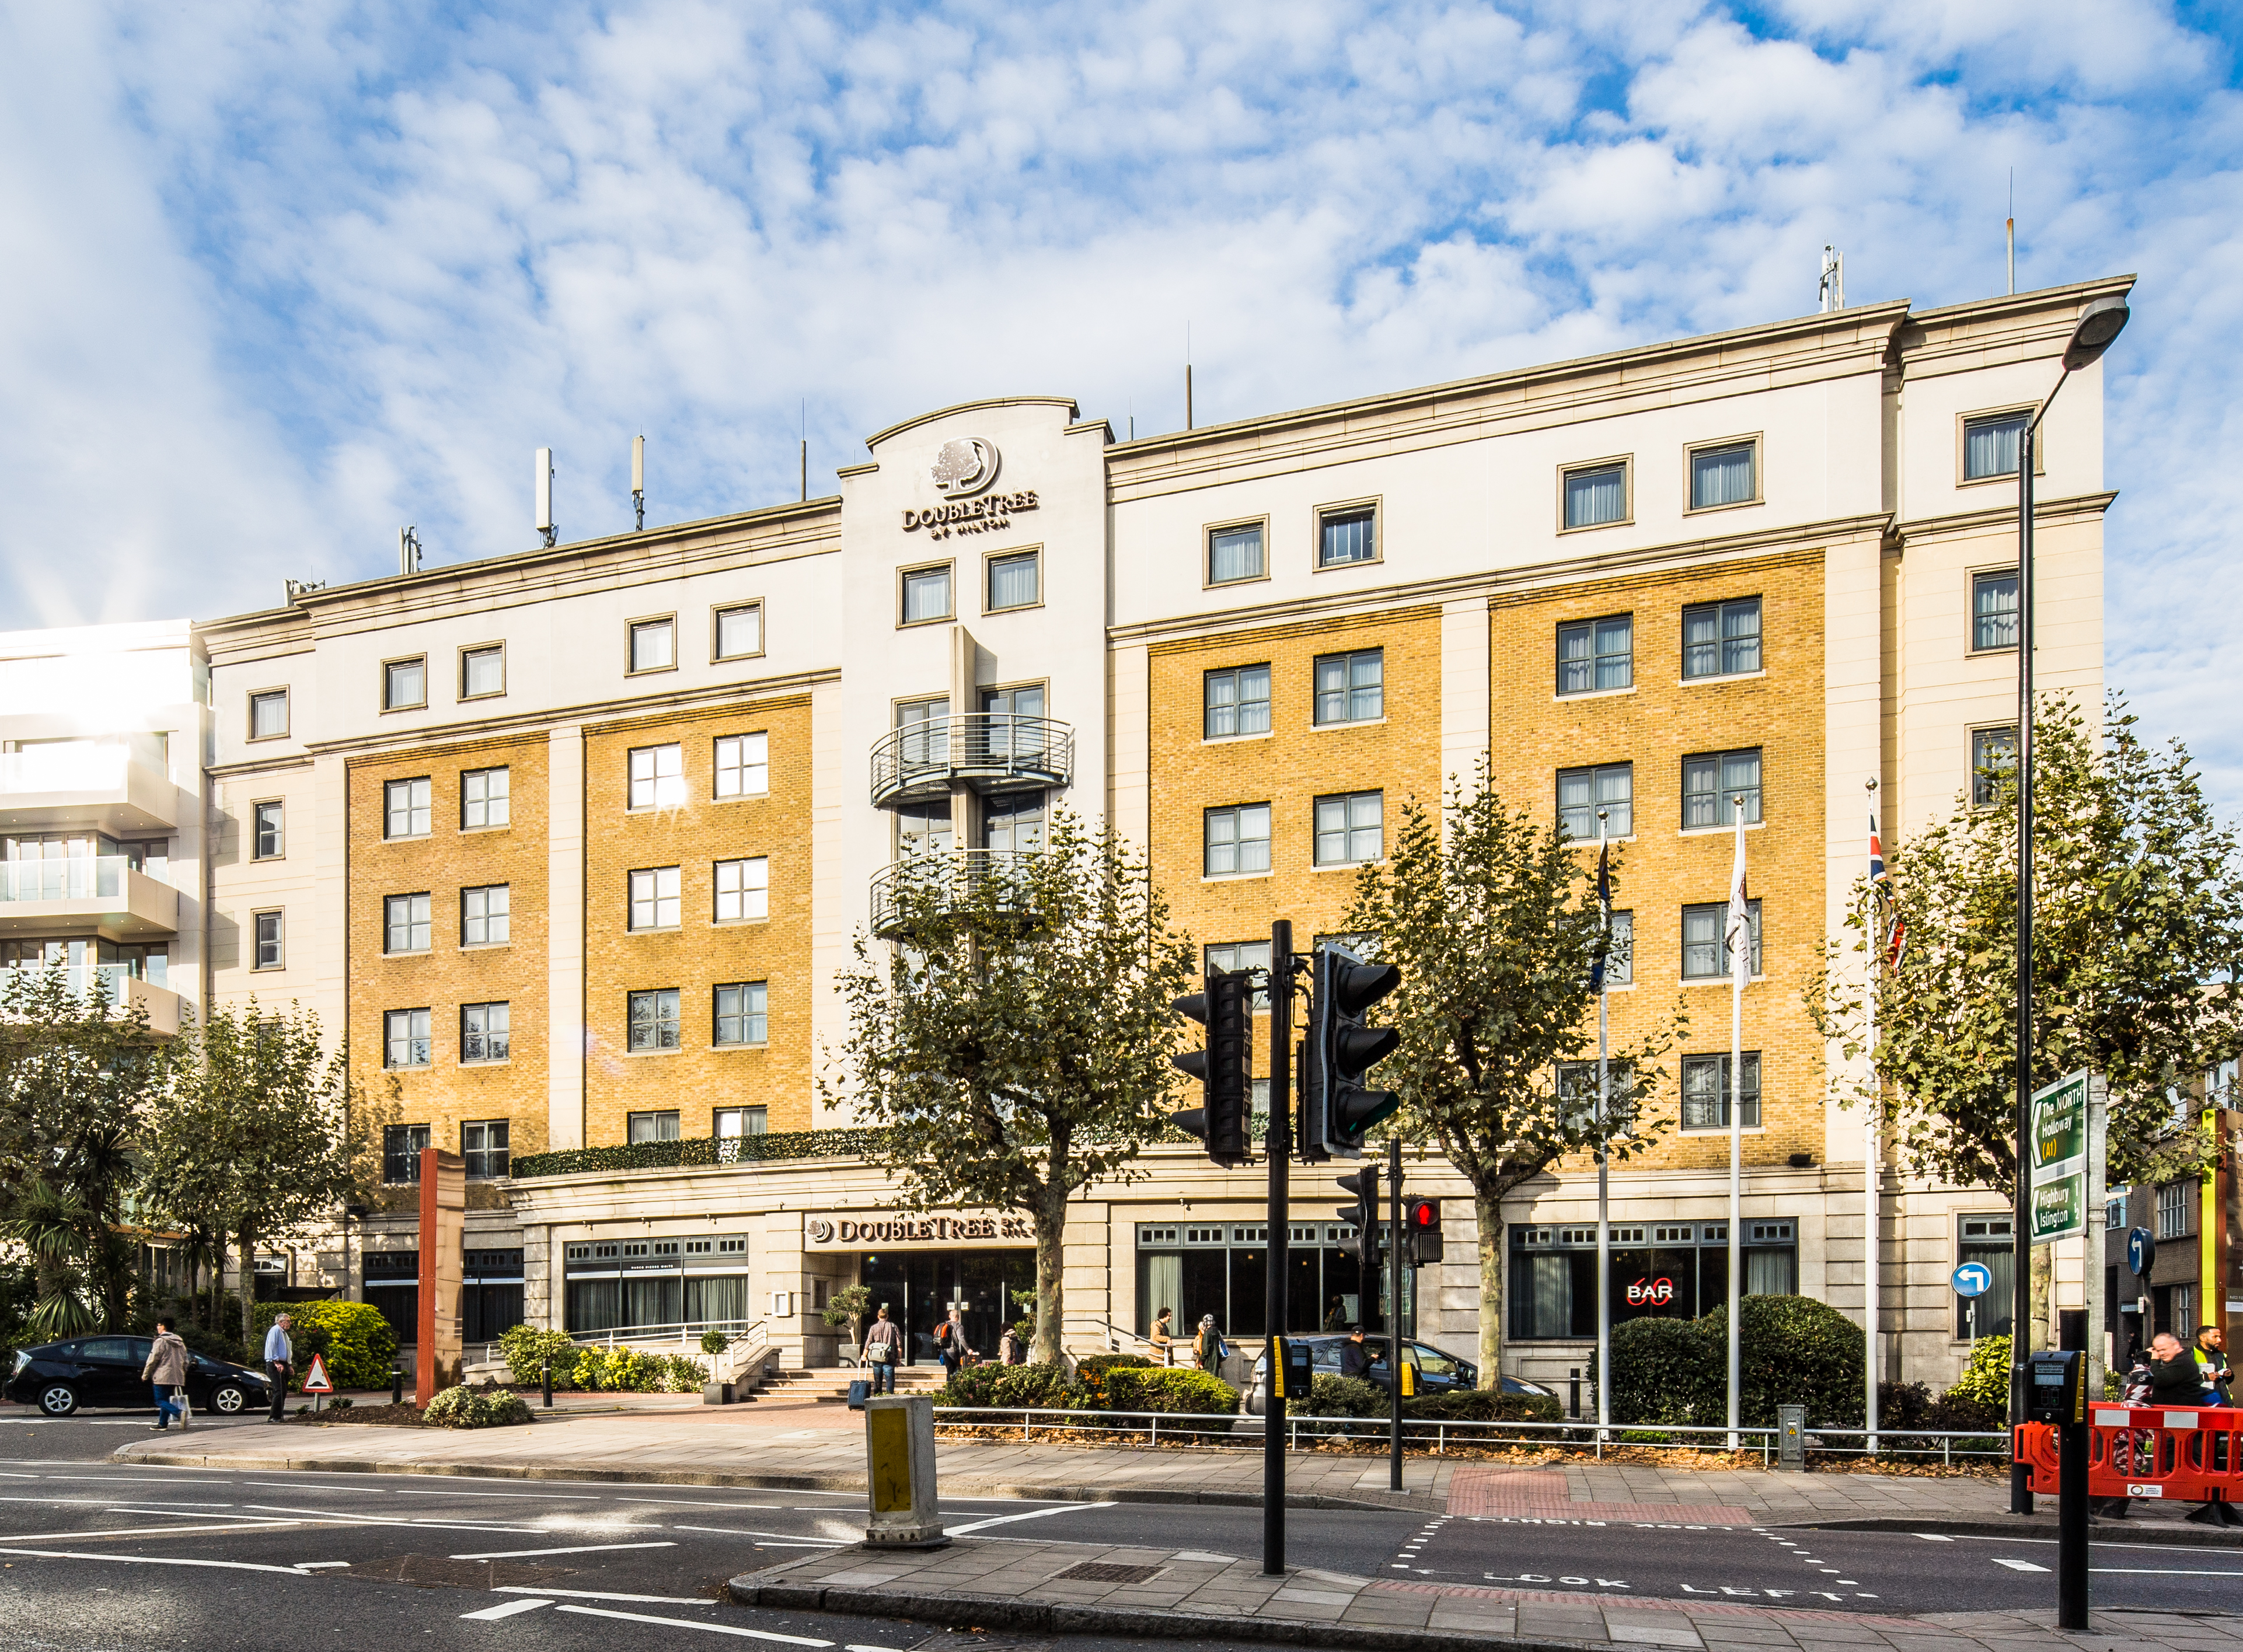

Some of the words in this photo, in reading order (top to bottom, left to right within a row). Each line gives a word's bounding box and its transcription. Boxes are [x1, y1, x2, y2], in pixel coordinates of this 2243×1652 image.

[930, 526, 947, 537] BY
[956, 516, 1008, 532] HILTON
[2042, 1102, 2054, 1119] The
[2056, 1085, 2083, 1113] NORTH
[2042, 1115, 2073, 1138] Holloway
[2042, 1138, 2057, 1161] (A1)
[2040, 1186, 2070, 1208] Highbury
[2075, 1181, 2078, 1197] 1
[1001, 1217, 1020, 1225] BY
[2040, 1209, 2068, 1228] Islington
[1001, 1227, 1036, 1236] HILT
[1627, 1286, 1673, 1298] BAR
[1495, 1518, 1607, 1526] RIGHT
[1483, 1573, 1631, 1588] LOOK
[1680, 1584, 1849, 1601] LEFT
